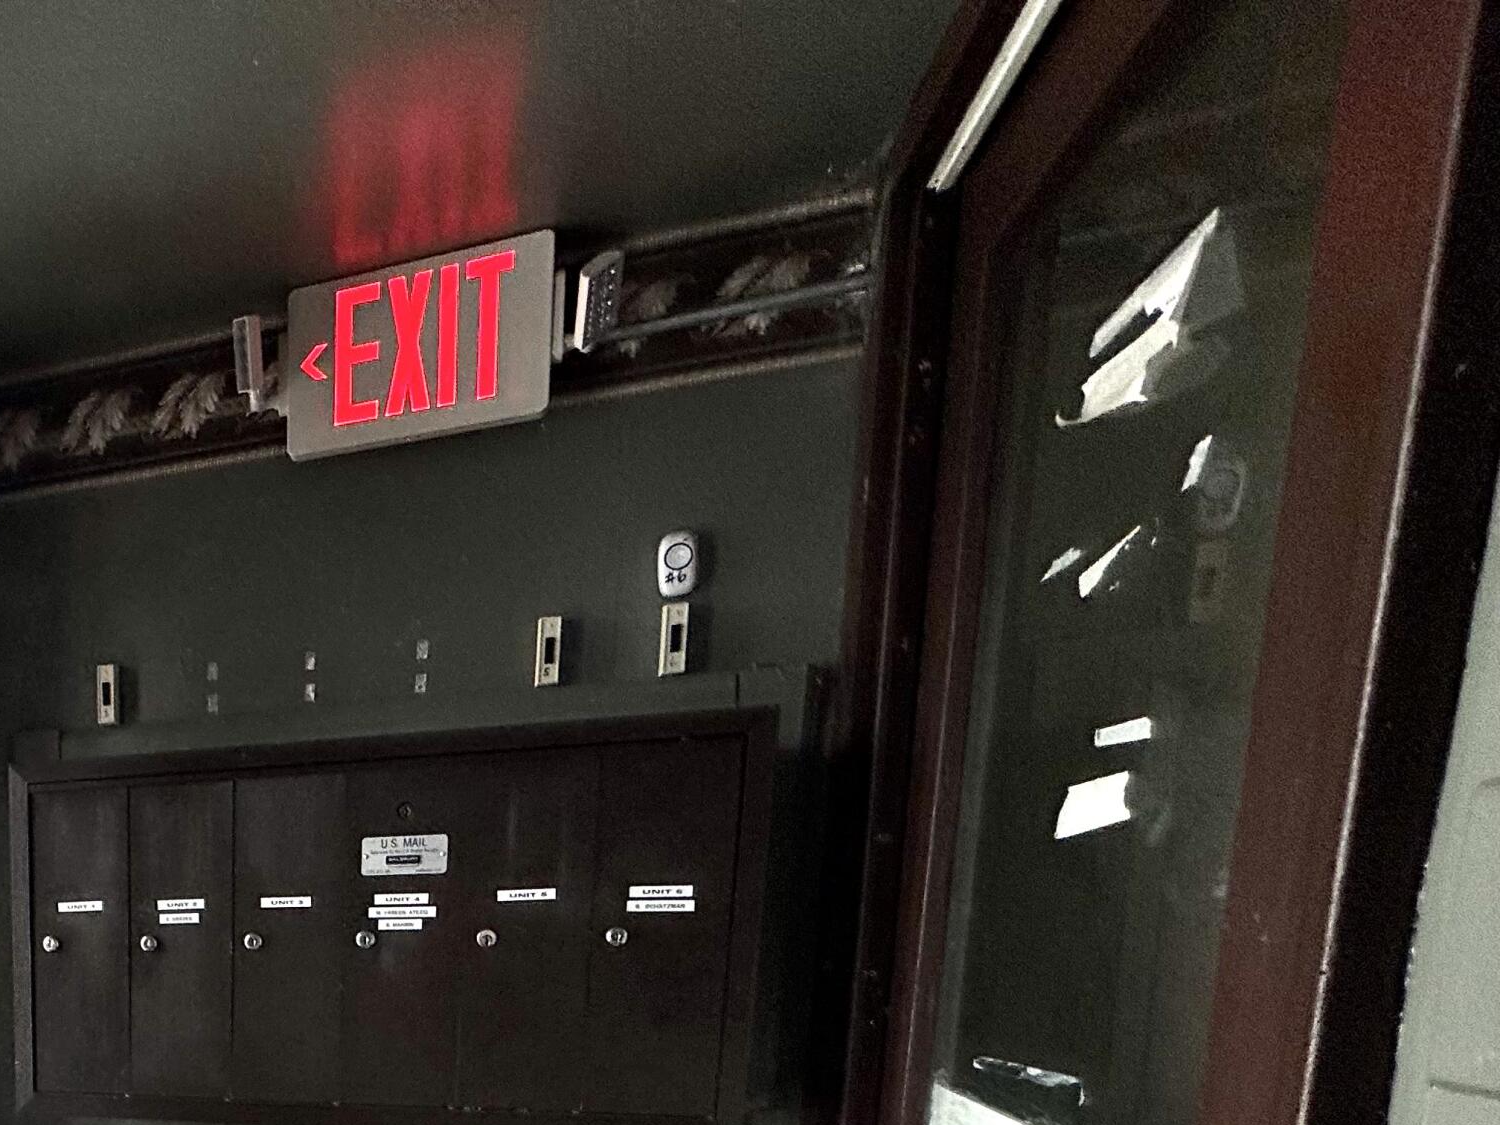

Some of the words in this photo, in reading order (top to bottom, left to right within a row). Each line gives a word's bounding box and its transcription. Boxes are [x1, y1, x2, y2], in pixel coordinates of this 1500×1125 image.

[332, 249, 517, 427] EXIT
[665, 570, 687, 584] #6
[403, 837, 429, 848] MAIL
